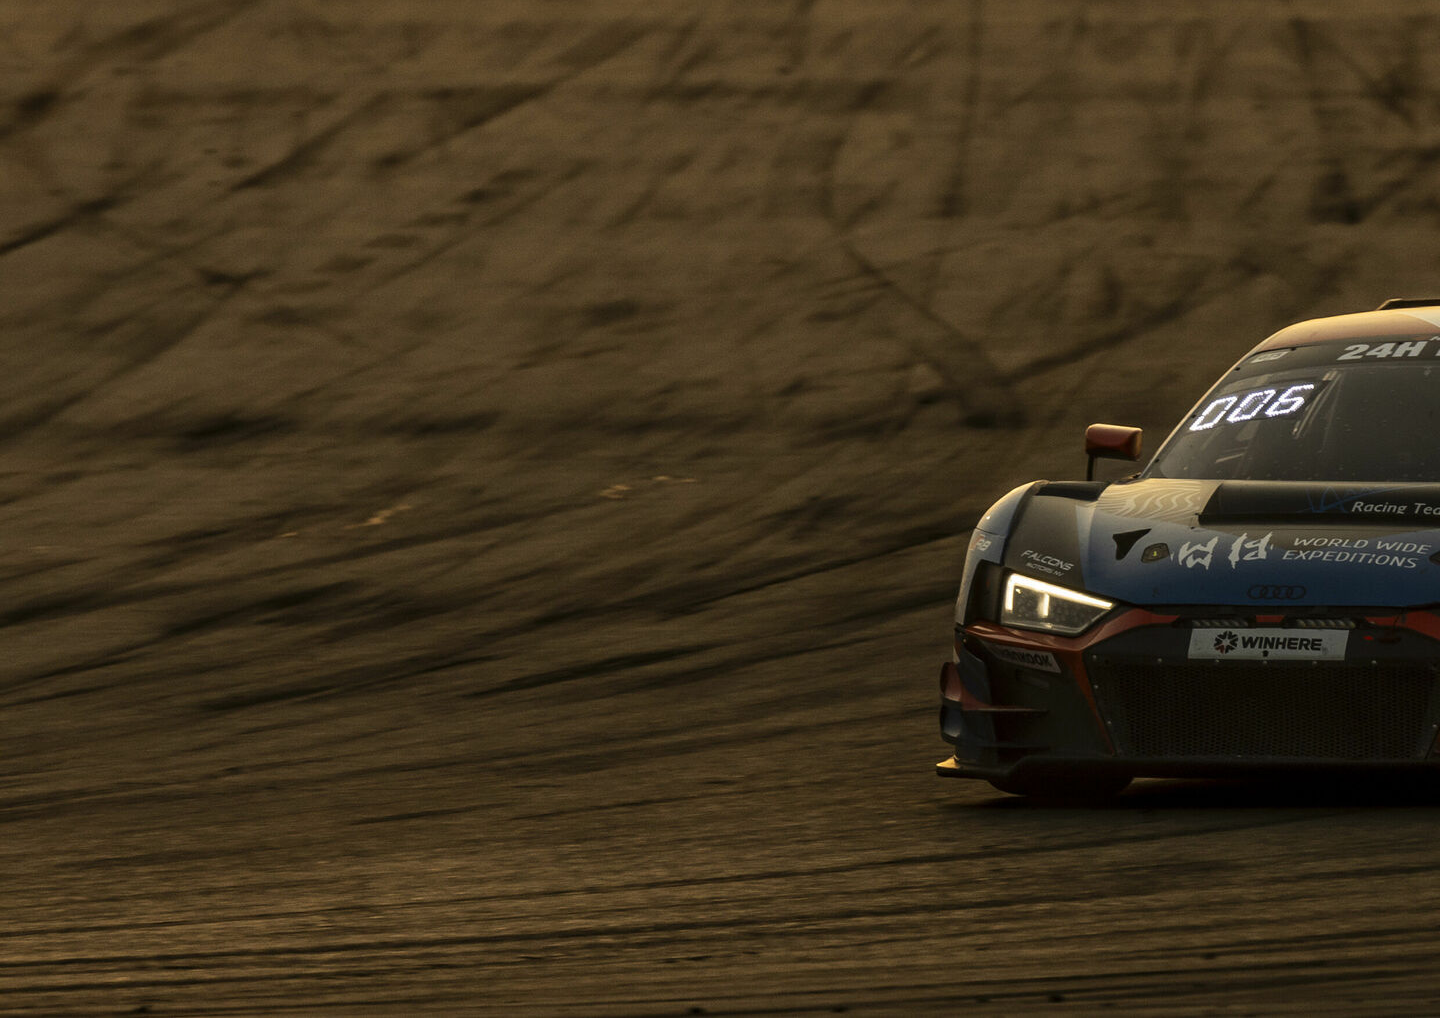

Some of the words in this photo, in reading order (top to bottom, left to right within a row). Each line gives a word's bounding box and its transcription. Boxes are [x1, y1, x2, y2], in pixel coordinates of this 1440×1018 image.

[1336, 340, 1428, 361] 24H
[1189, 383, 1315, 431] 006
[1351, 501, 1407, 515] Racing
[1293, 537, 1369, 549] WORLD
[1376, 540, 1432, 555] WIDE
[1020, 549, 1075, 571] FALCONS
[1241, 636, 1323, 652] WINHERE
